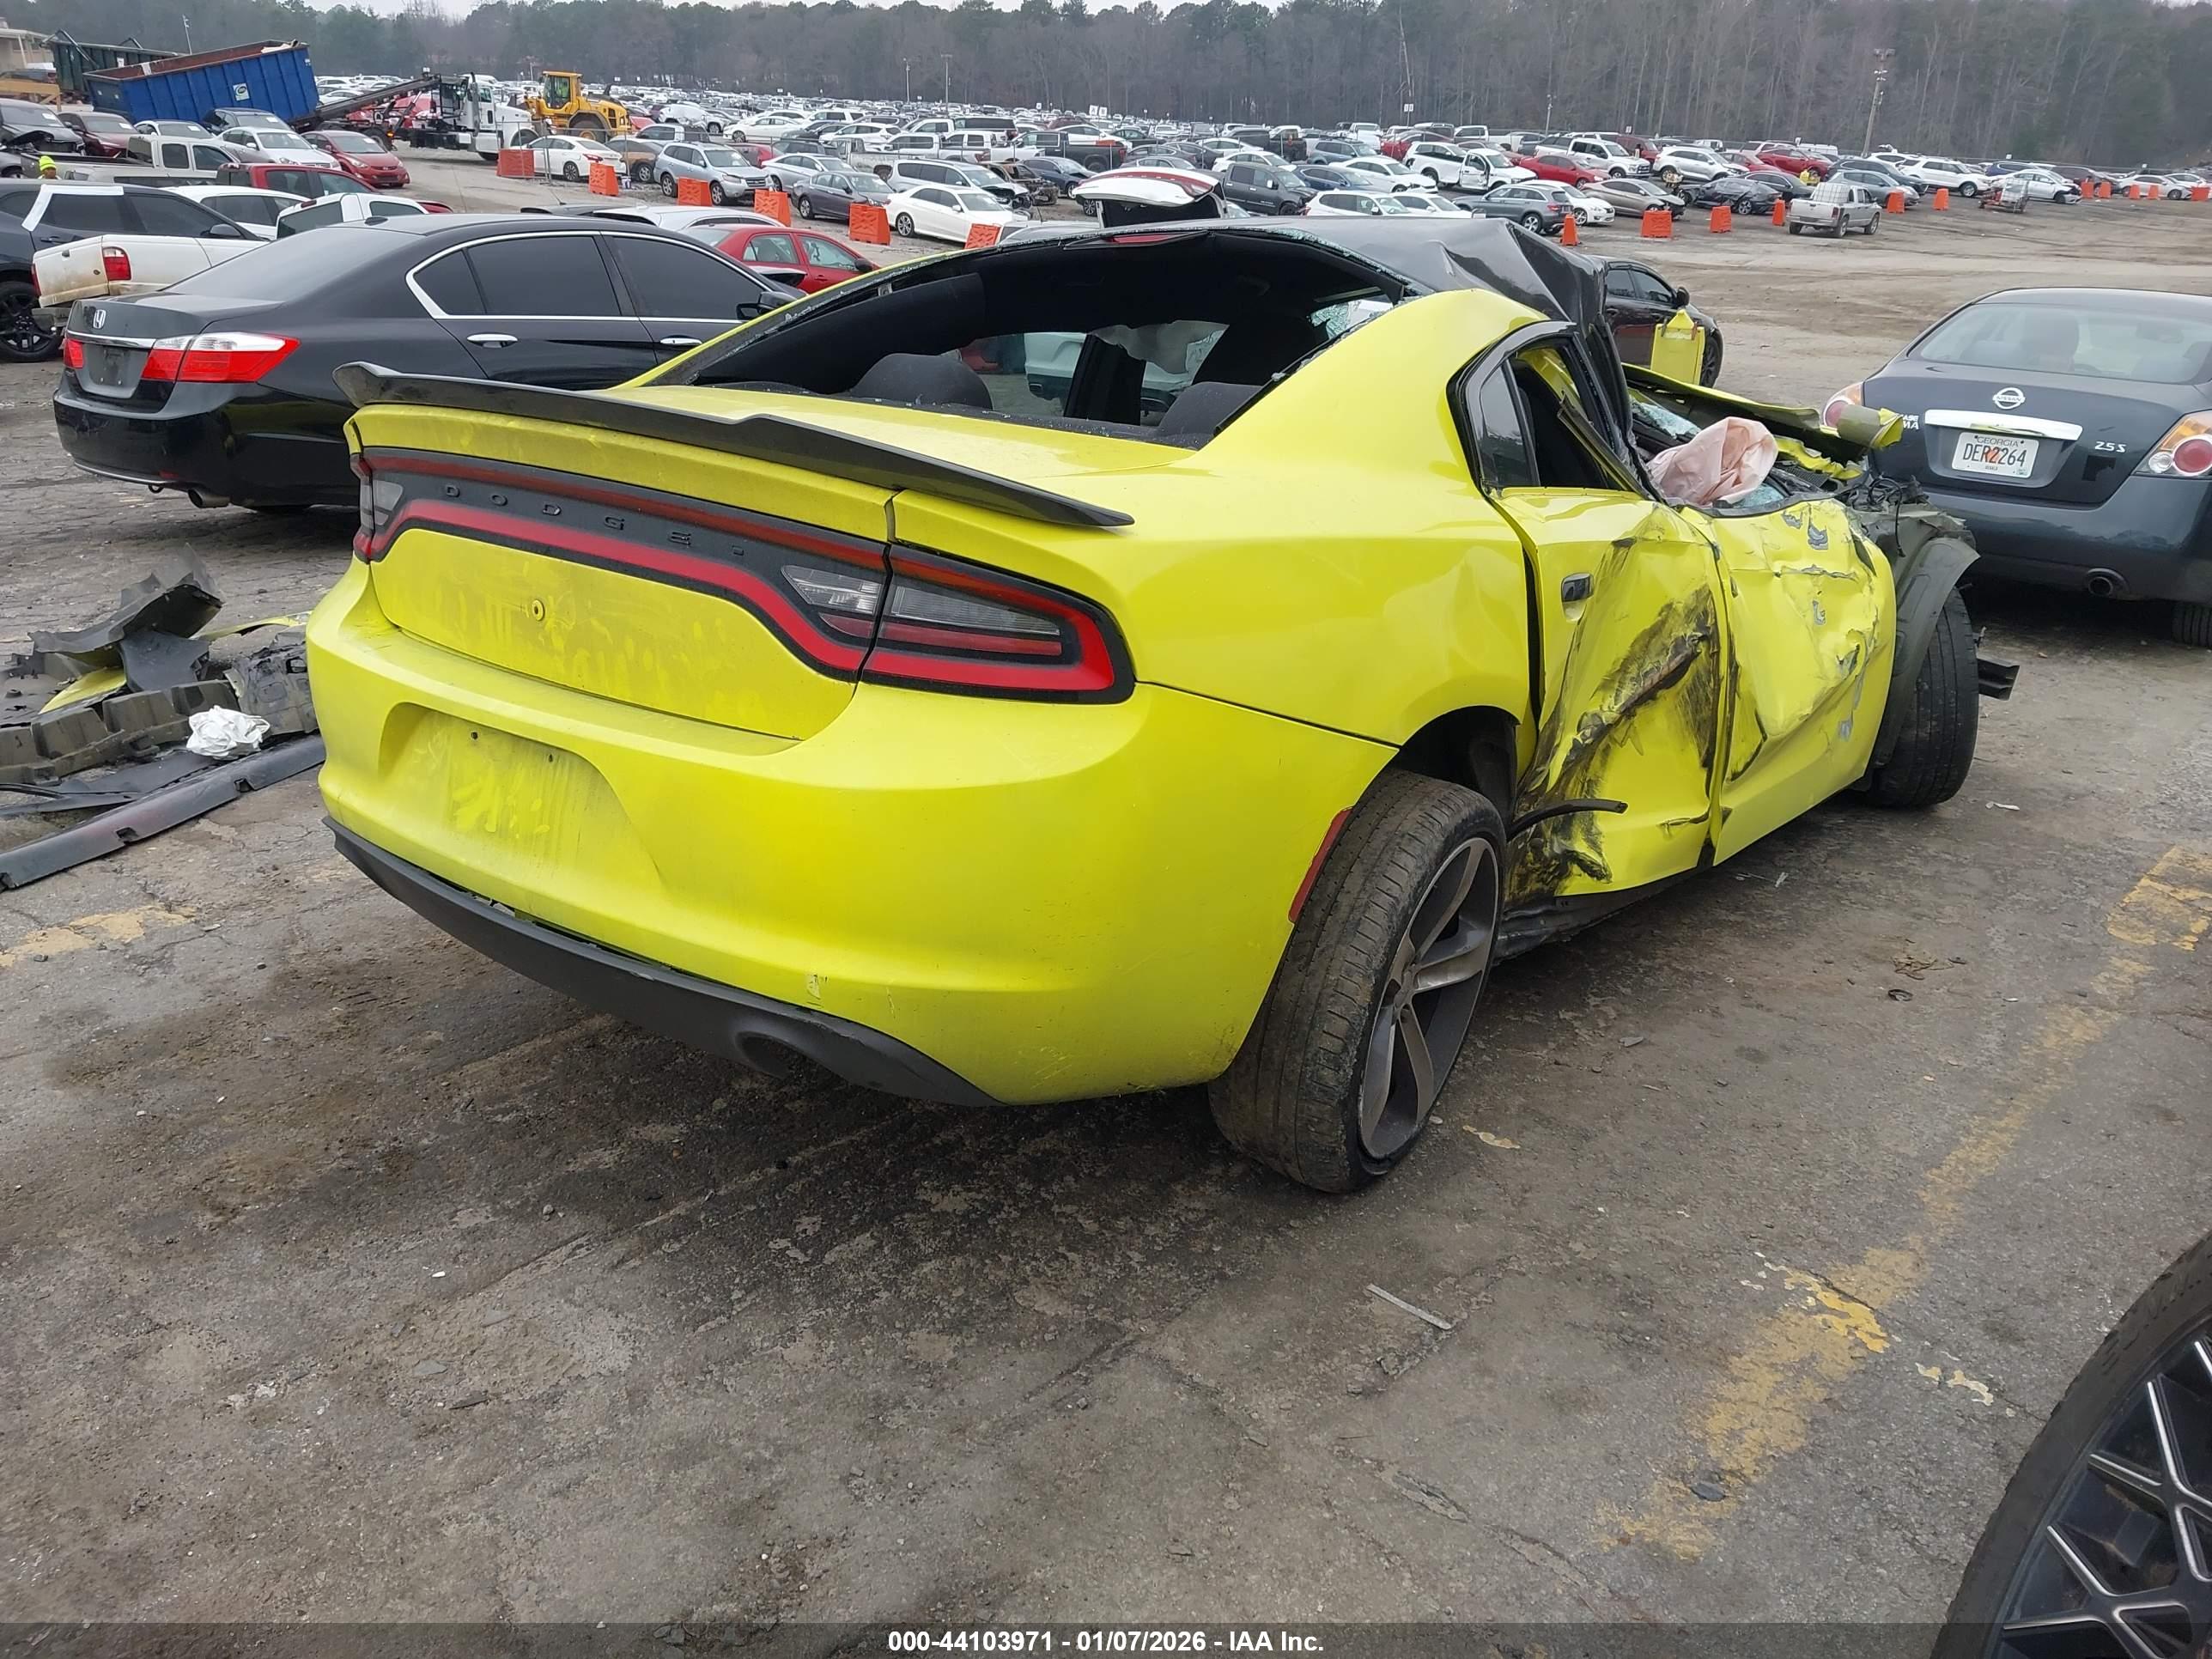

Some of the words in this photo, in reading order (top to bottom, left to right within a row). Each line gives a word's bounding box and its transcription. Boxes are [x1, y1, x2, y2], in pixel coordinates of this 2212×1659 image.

[1977, 436, 2019, 447] GEORGIA
[1962, 443, 2027, 467] DER2264
[445, 484, 692, 547] DODGE
